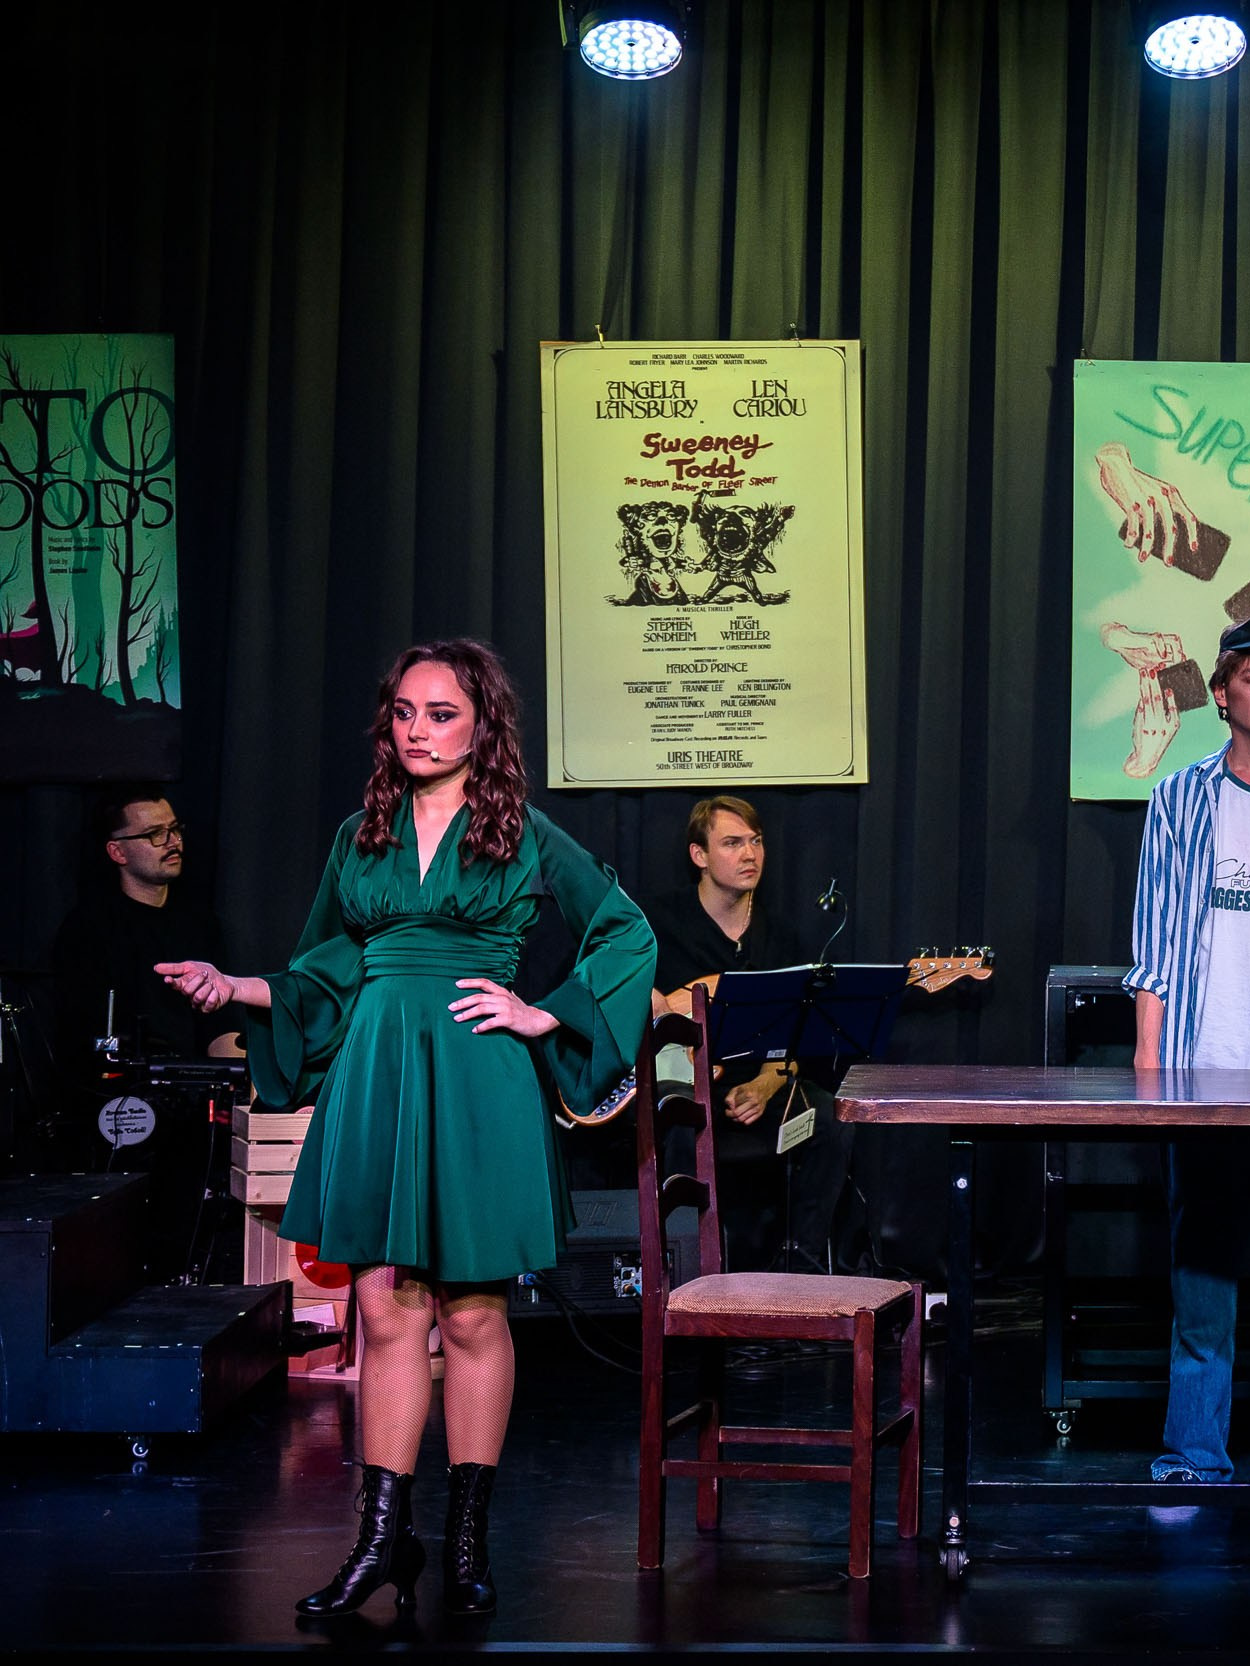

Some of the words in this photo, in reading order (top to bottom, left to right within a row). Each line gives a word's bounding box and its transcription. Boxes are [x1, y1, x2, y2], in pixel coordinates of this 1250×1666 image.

[606, 380, 686, 400] ANGELA
[752, 380, 788, 398] LEN
[595, 399, 697, 419] LANSBURY
[733, 398, 807, 417] CARIOU
[640, 432, 774, 459] Sweeney
[666, 455, 745, 481] Todd
[646, 621, 693, 632] STEPHEN
[730, 620, 760, 630] HUGH
[643, 632, 697, 643] SONDHEIM
[720, 631, 770, 641] WHEELER
[666, 663, 708, 674] HAROLD
[710, 662, 748, 673] PRINCE
[627, 686, 654, 694] EUGENE
[655, 685, 668, 693] LEE
[682, 684, 709, 693] FRANNE
[711, 684, 724, 692] LEE
[737, 684, 752, 692] KEN
[753, 683, 792, 692] BILLINGTON
[644, 701, 679, 709] JONATHAN
[681, 700, 705, 708] TUNICK
[720, 699, 738, 707] PAUL
[738, 699, 776, 707] GEMIGNANI
[704, 711, 726, 719] LARRY
[727, 710, 752, 718] FULLER
[667, 751, 692, 763] URIS
[695, 750, 744, 762] THEATRE
